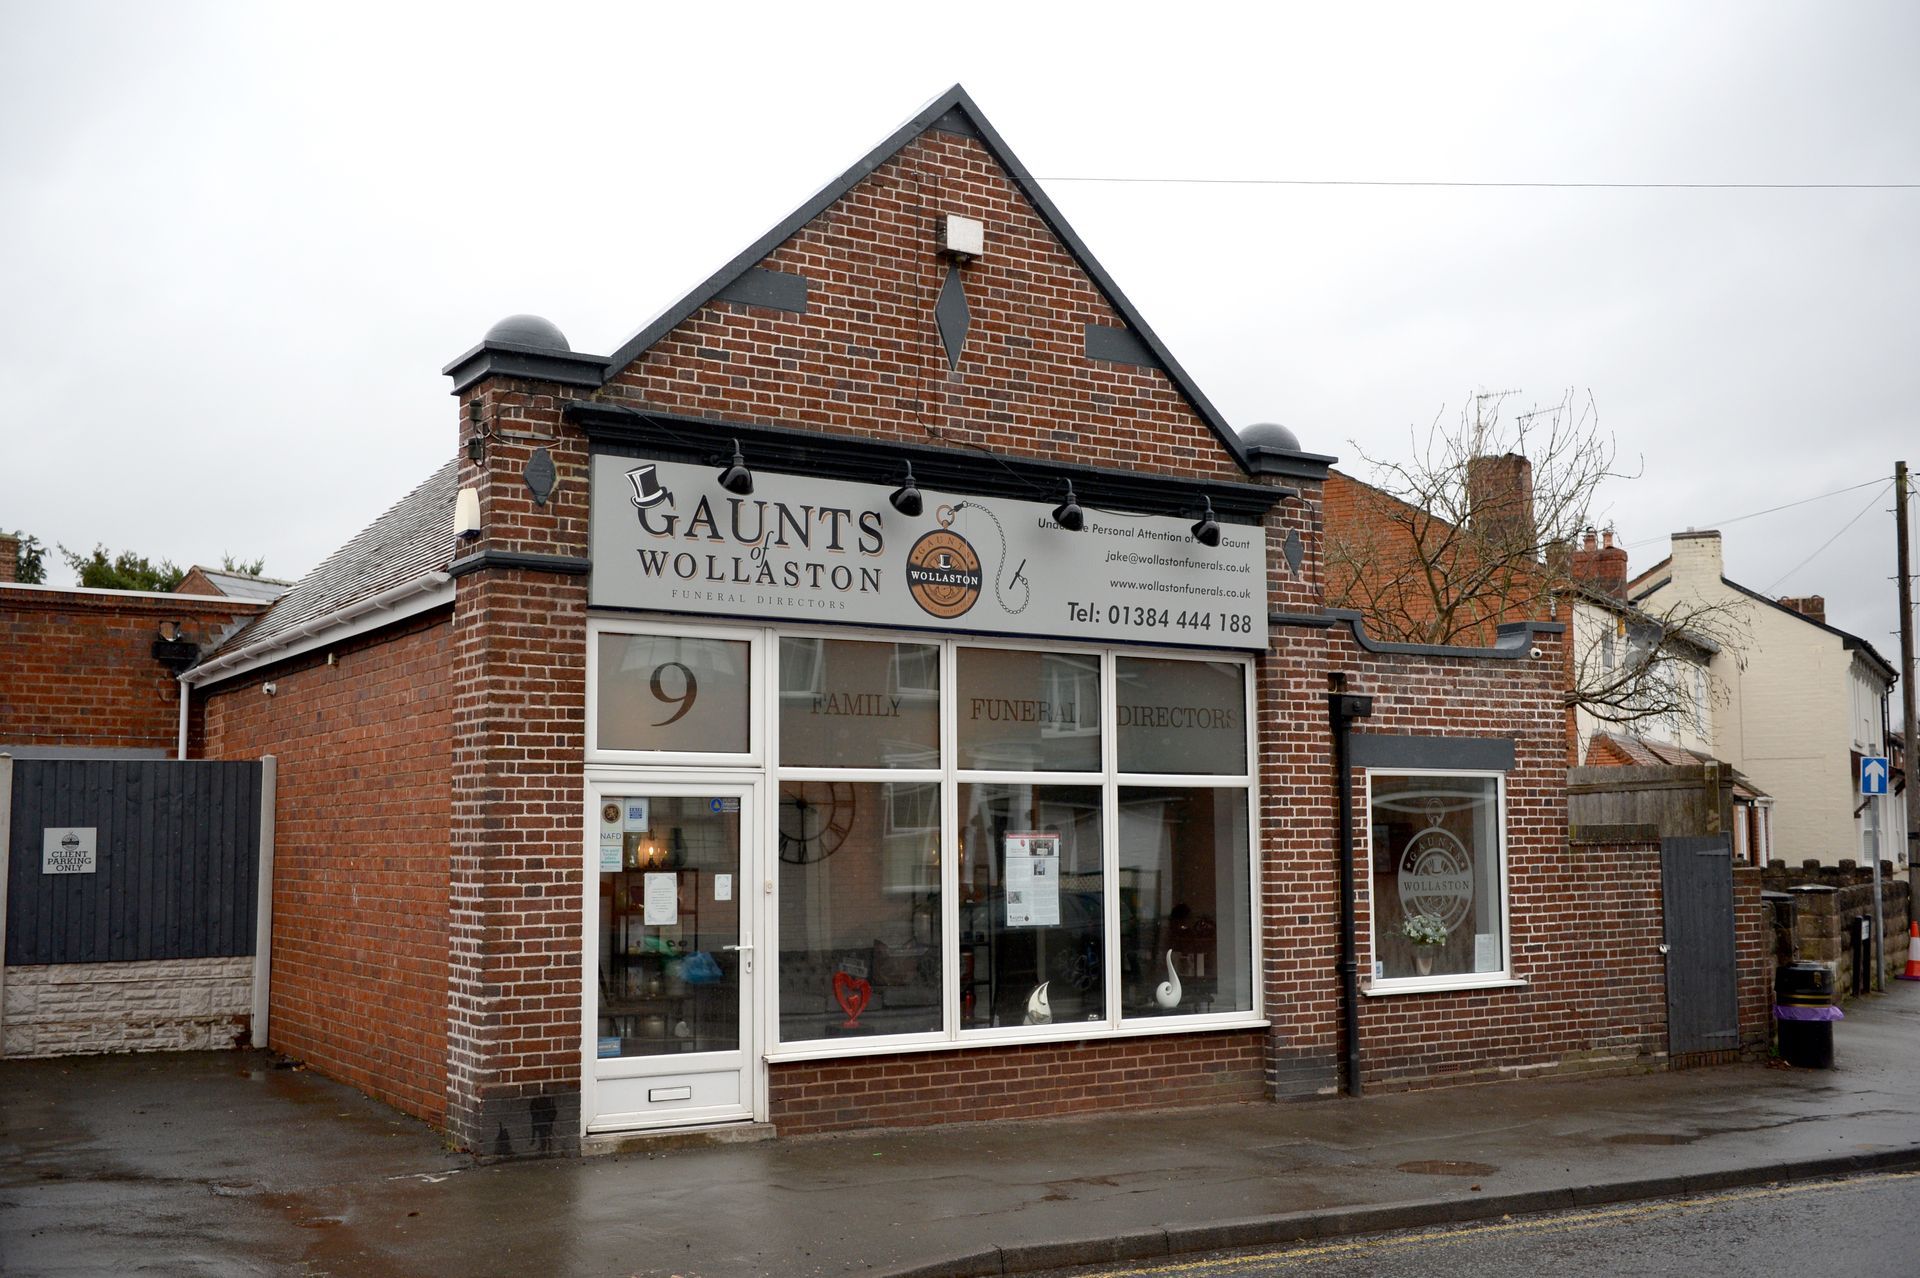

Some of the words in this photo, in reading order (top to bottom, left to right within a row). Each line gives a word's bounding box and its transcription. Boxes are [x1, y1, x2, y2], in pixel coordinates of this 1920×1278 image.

[637, 494, 883, 556] GAUNTS
[1092, 523, 1135, 537] Personal
[1137, 528, 1182, 542] Attention
[1221, 537, 1250, 549] Gaunt
[750, 530, 775, 569] of
[918, 536, 973, 559] GAUNTS
[636, 548, 883, 594] WOLLASTON
[1105, 550, 1251, 574] jake@wollastonfunerals.co.uk
[910, 570, 978, 585] WOLLASTON
[1110, 578, 1251, 599] www.wollastonfunerals.co.uk
[671, 588, 746, 604] FUNERAL
[757, 595, 846, 610] DIRECTORS
[1067, 601, 1100, 623] Tel:
[1108, 605, 1169, 628] 01384
[1176, 610, 1211, 631] 444
[1220, 613, 1252, 633] 188
[649, 661, 698, 727] 9
[810, 691, 902, 718] FAMILY
[970, 698, 1081, 724] FUNERAL
[1116, 705, 1239, 729] DIRECTORS
[47, 857, 92, 865] PARKING
[51, 850, 89, 858] CLIENT
[1409, 837, 1461, 861] GAUNTS
[55, 864, 83, 872] ONLY
[1403, 880, 1470, 891] WOLLASTON
